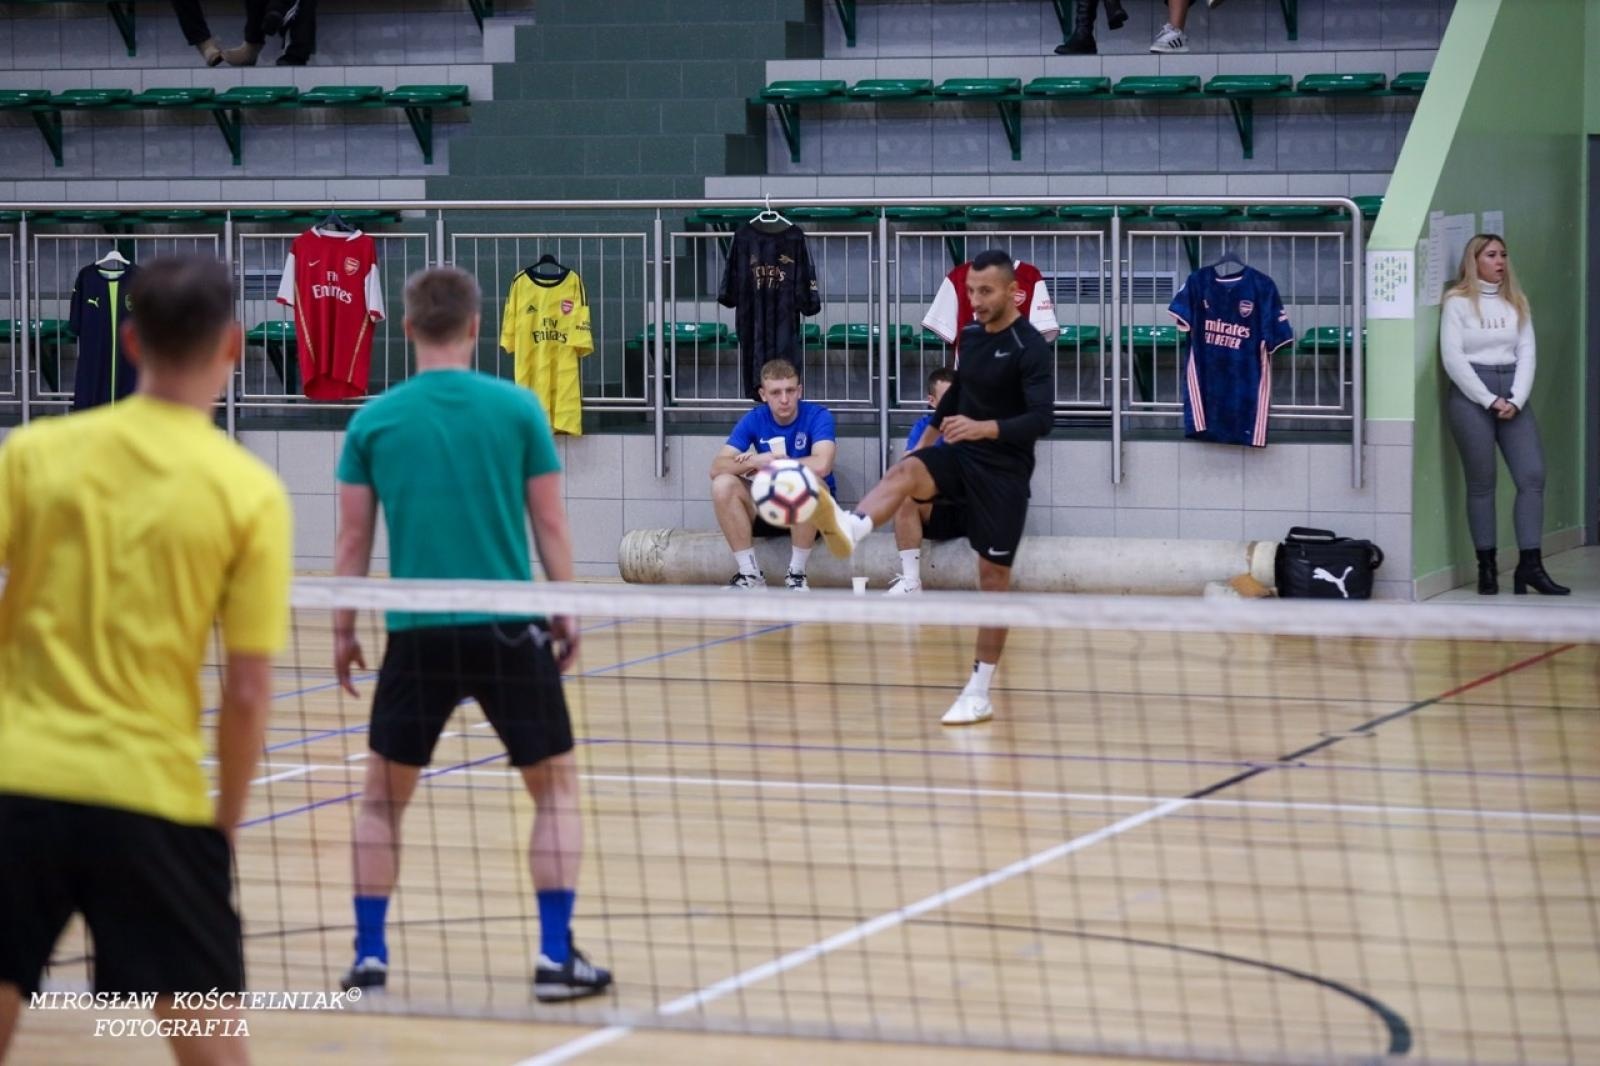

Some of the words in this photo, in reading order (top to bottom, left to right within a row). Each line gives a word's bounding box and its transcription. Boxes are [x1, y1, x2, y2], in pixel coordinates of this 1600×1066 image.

[312, 282, 352, 304] Emirtes
[532, 328, 568, 344] Emiraes
[1205, 318, 1250, 338] mirates
